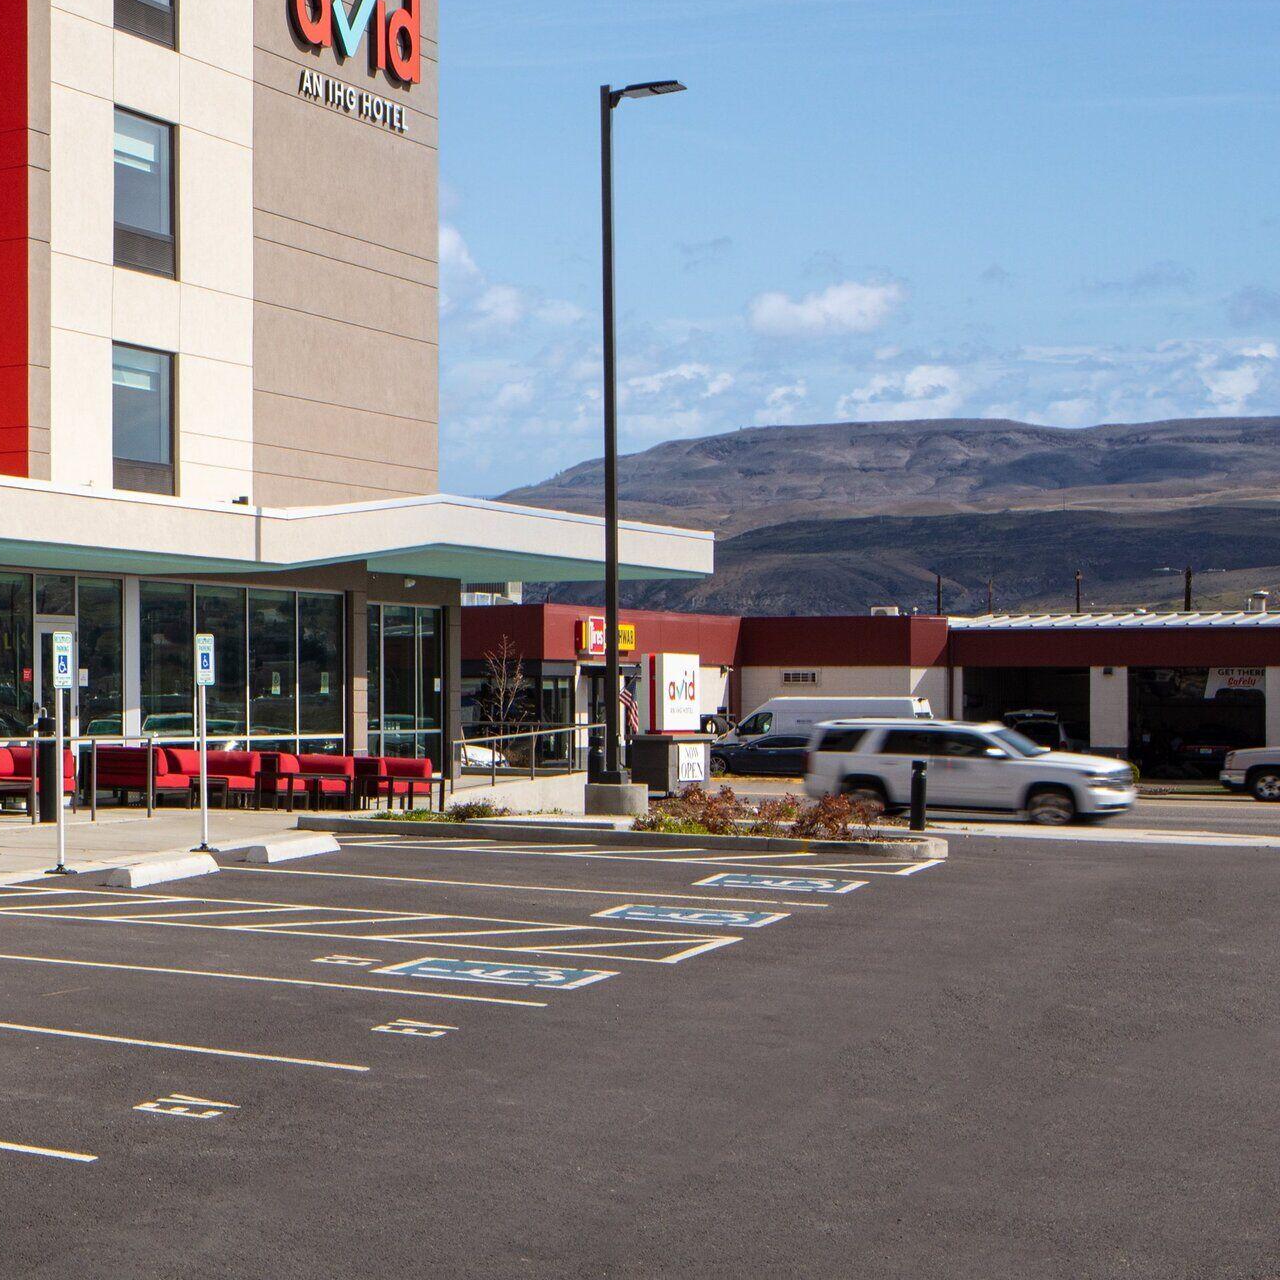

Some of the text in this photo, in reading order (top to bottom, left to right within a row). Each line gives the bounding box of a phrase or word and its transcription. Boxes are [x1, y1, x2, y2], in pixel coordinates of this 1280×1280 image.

[302, 70, 409, 131] AN IHG HOTEL
[1217, 669, 1235, 677] GET
[1227, 677, 1257, 687] Safely
[668, 670, 696, 701] avid
[681, 762, 704, 779] OPEN
[310, 954, 383, 966] EV
[371, 1018, 459, 1037] EV
[132, 1093, 241, 1119] EV
